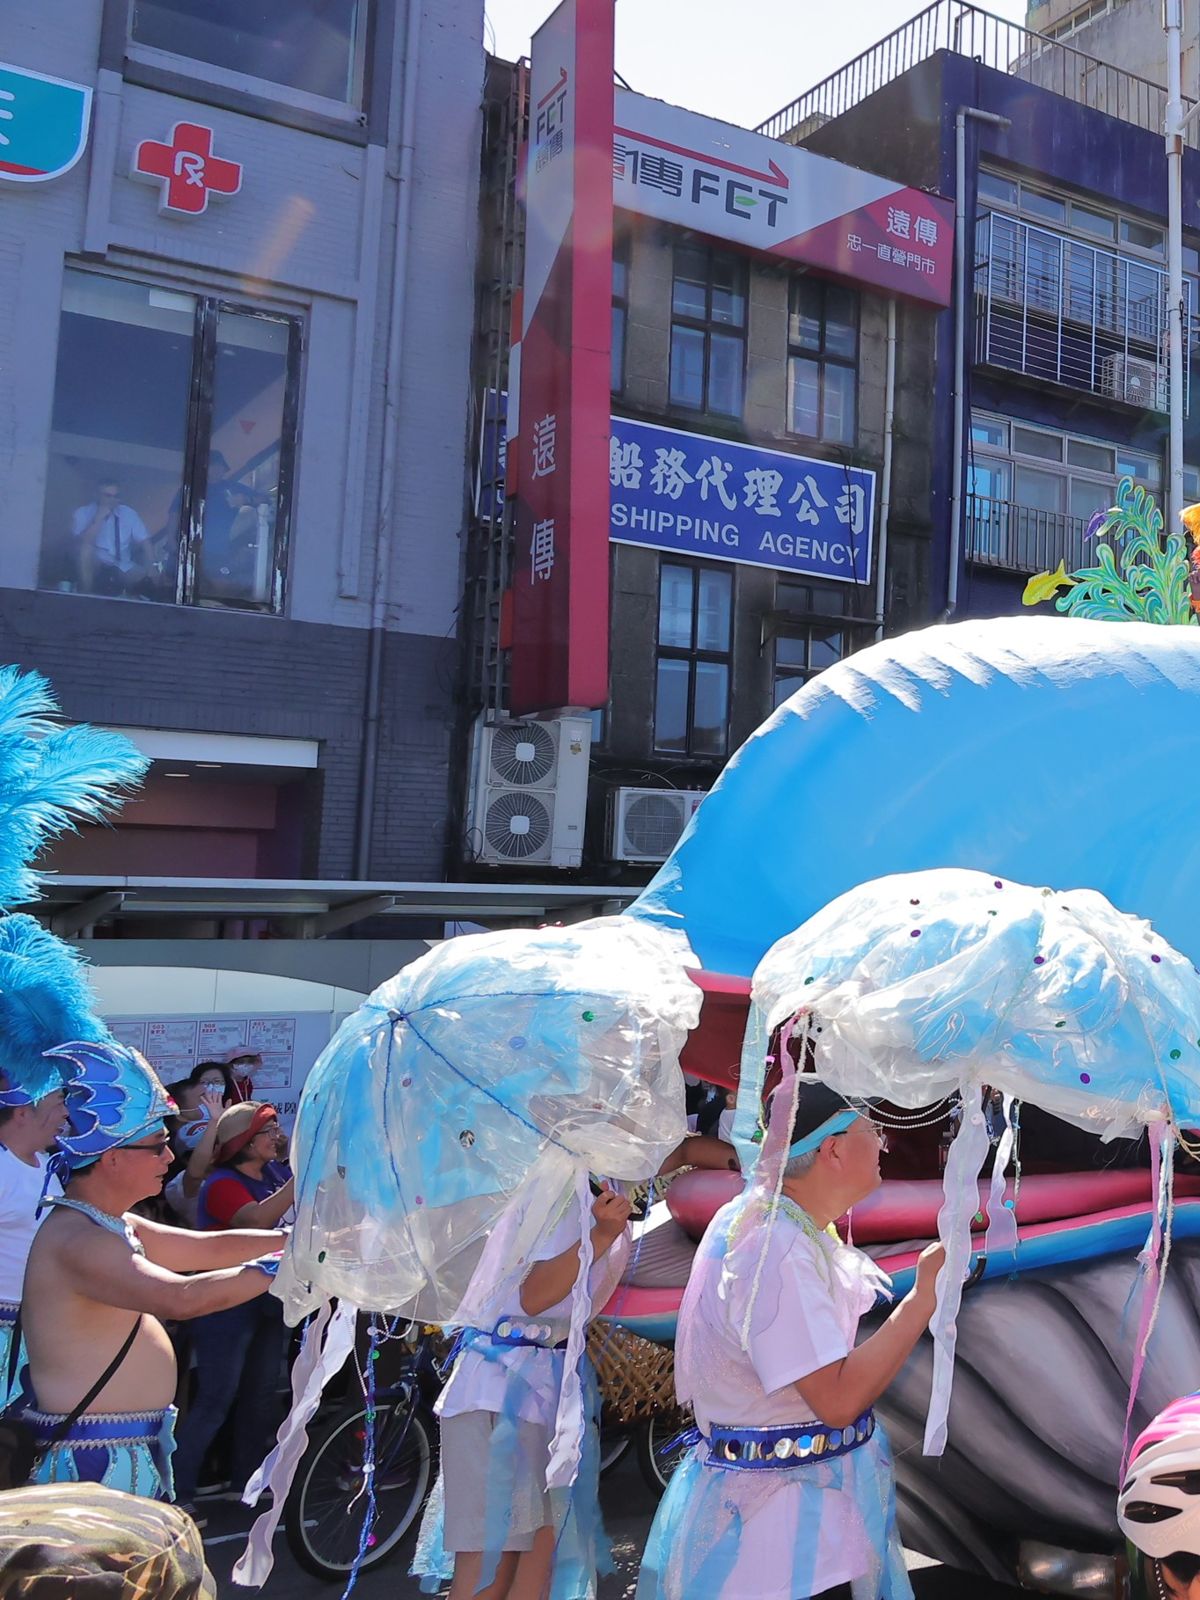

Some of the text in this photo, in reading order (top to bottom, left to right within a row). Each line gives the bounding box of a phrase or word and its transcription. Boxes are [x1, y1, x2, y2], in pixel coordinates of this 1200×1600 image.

[536, 90, 567, 145] FET
[691, 168, 788, 228] FET
[886, 206, 938, 248] 遠傳
[846, 233, 936, 275] 忠一直營門市
[530, 413, 556, 585] 遠傳
[609, 435, 865, 536] 船務代理公司
[610, 503, 861, 568] SHIPPING AGENCY
